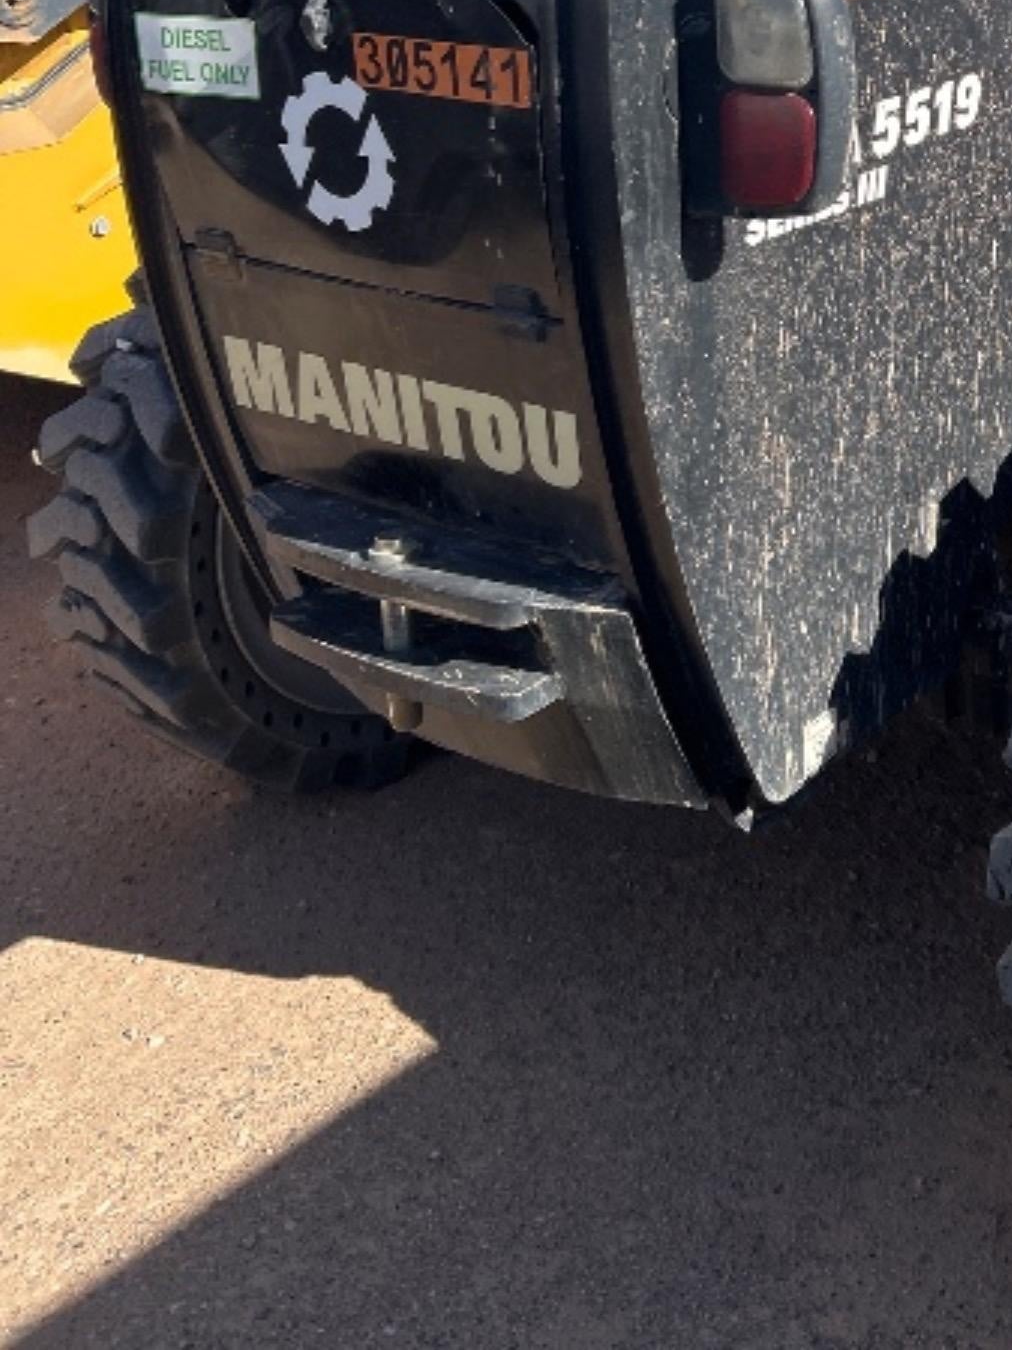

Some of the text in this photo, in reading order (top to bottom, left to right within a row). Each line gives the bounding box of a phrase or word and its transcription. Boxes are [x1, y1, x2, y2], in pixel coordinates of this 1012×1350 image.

[160, 26, 232, 52] DIESEL
[358, 35, 520, 102] 305141
[148, 59, 250, 87] FUEL ONLY
[871, 72, 983, 158] 5519
[223, 335, 583, 490] MANITOU
